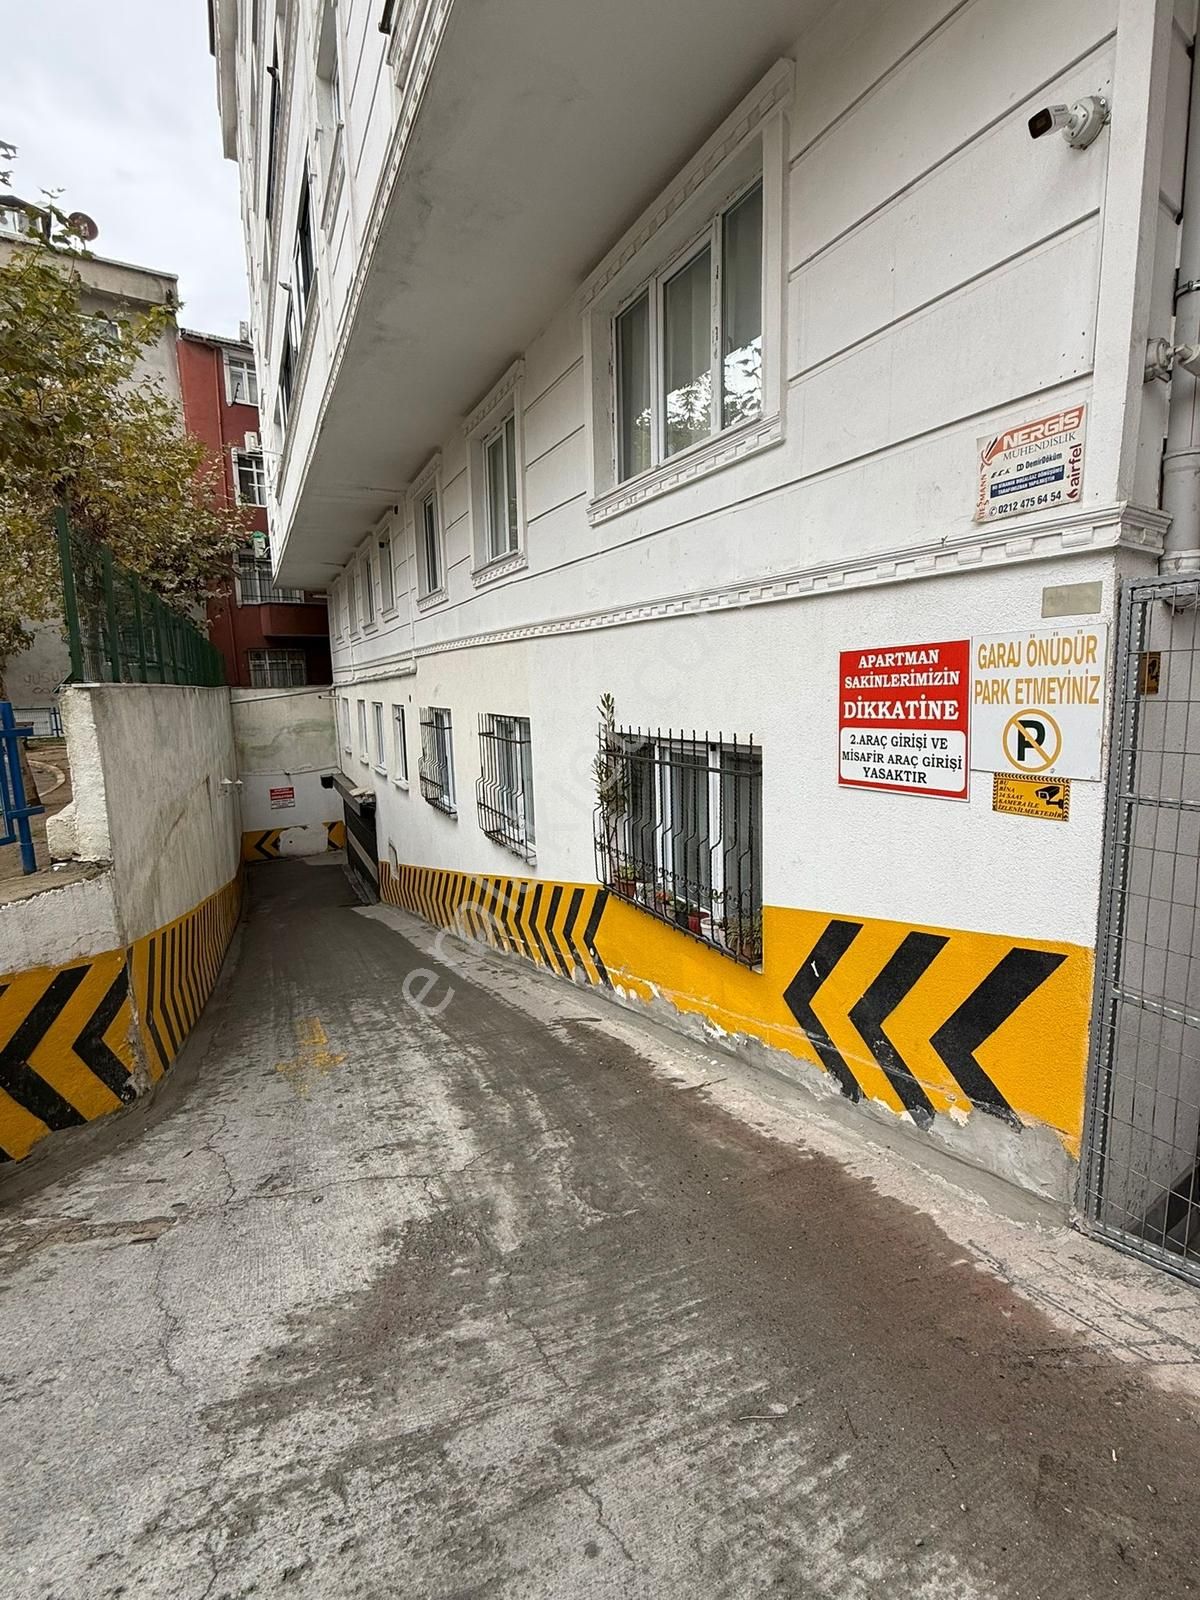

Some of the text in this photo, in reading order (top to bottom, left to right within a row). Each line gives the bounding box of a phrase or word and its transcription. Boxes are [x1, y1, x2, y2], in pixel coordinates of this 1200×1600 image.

[1066, 443, 1082, 487] airfel
[998, 491, 1062, 514] 0212 475 64 54
[858, 649, 940, 669] APARTMAN
[978, 629, 1098, 670] GARAJ ÖNÜDÜR
[844, 666, 960, 689] SAKİNLERİMİZİN
[974, 668, 1100, 705] PARK ETMEYİNİZ
[843, 694, 959, 720] DİKKATİNE
[849, 732, 948, 751] 2.ARAÇ GİRİŞİ VE
[842, 748, 963, 772] MİSAFİR ARAÇ GİRİŞİ
[863, 766, 927, 784] YASAKTIR
[998, 799, 1026, 807] KAMERA
